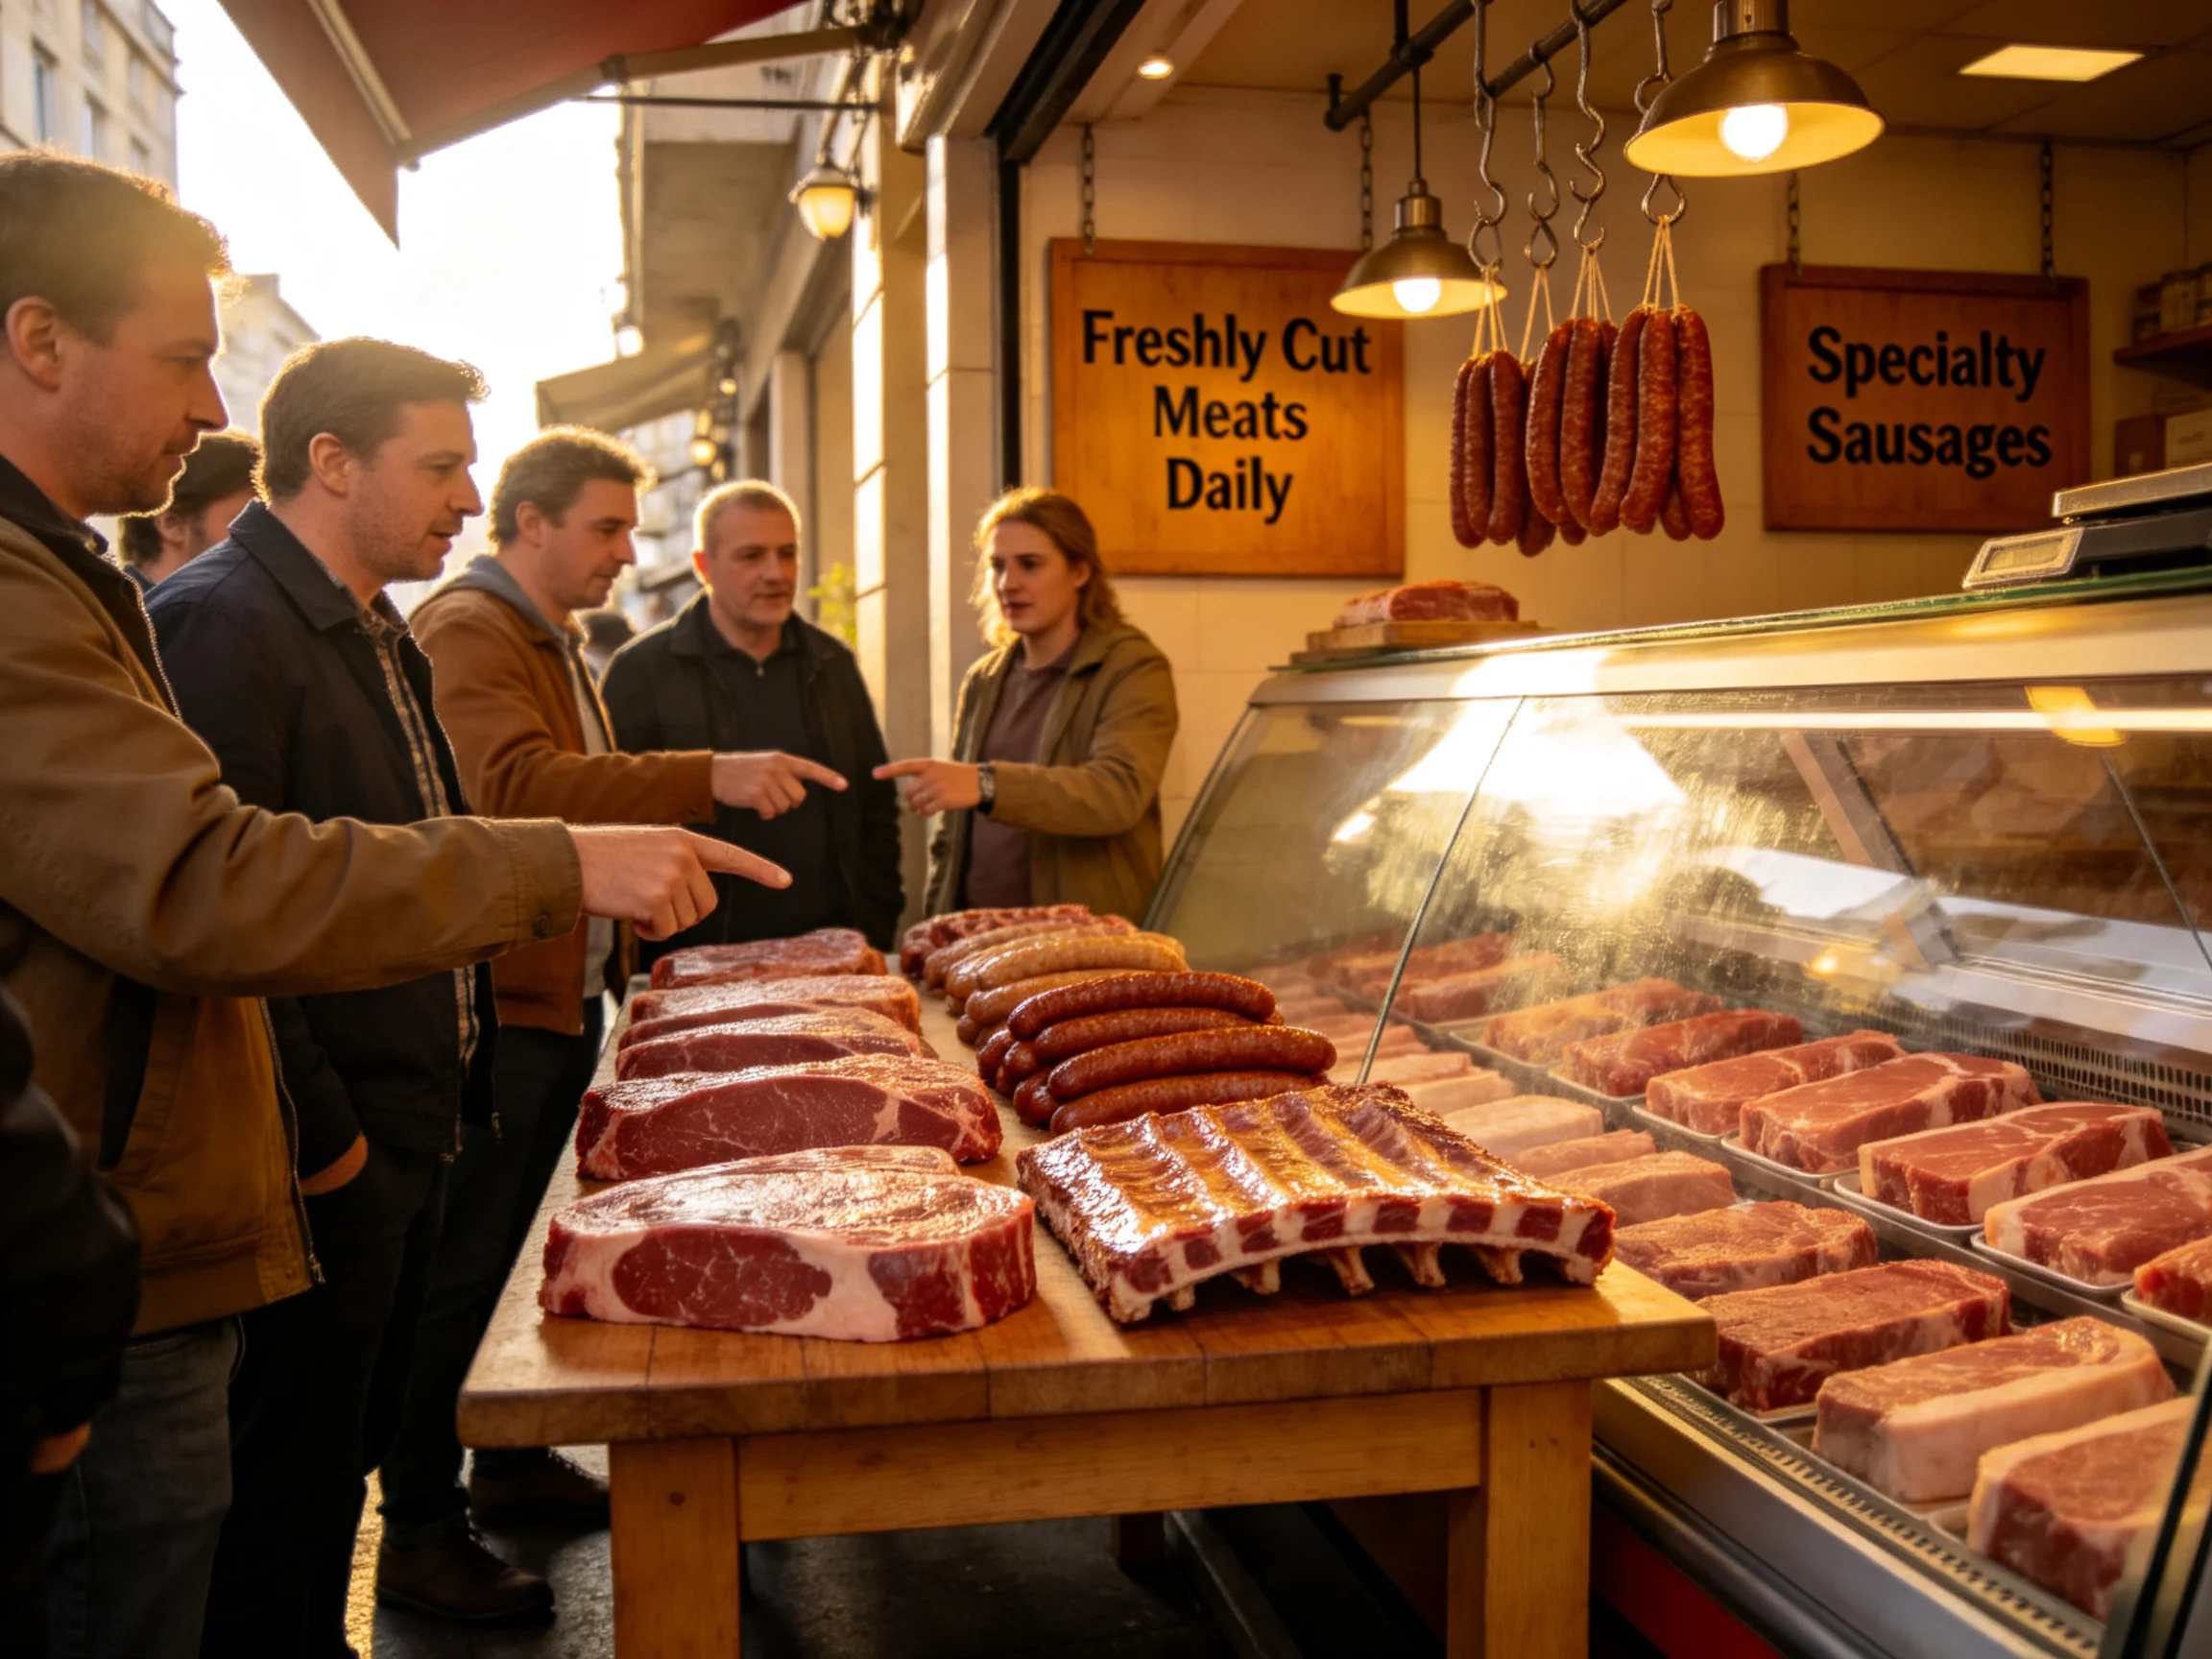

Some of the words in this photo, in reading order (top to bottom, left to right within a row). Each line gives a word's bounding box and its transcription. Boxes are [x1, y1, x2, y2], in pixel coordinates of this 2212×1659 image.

[1082, 308, 1268, 383] Freshly
[1281, 316, 1373, 375] Cut
[1807, 325, 2046, 402] Specialty
[1154, 385, 1310, 442] Meats
[1806, 406, 2053, 480] Sausages
[1166, 456, 1293, 525] Daily
